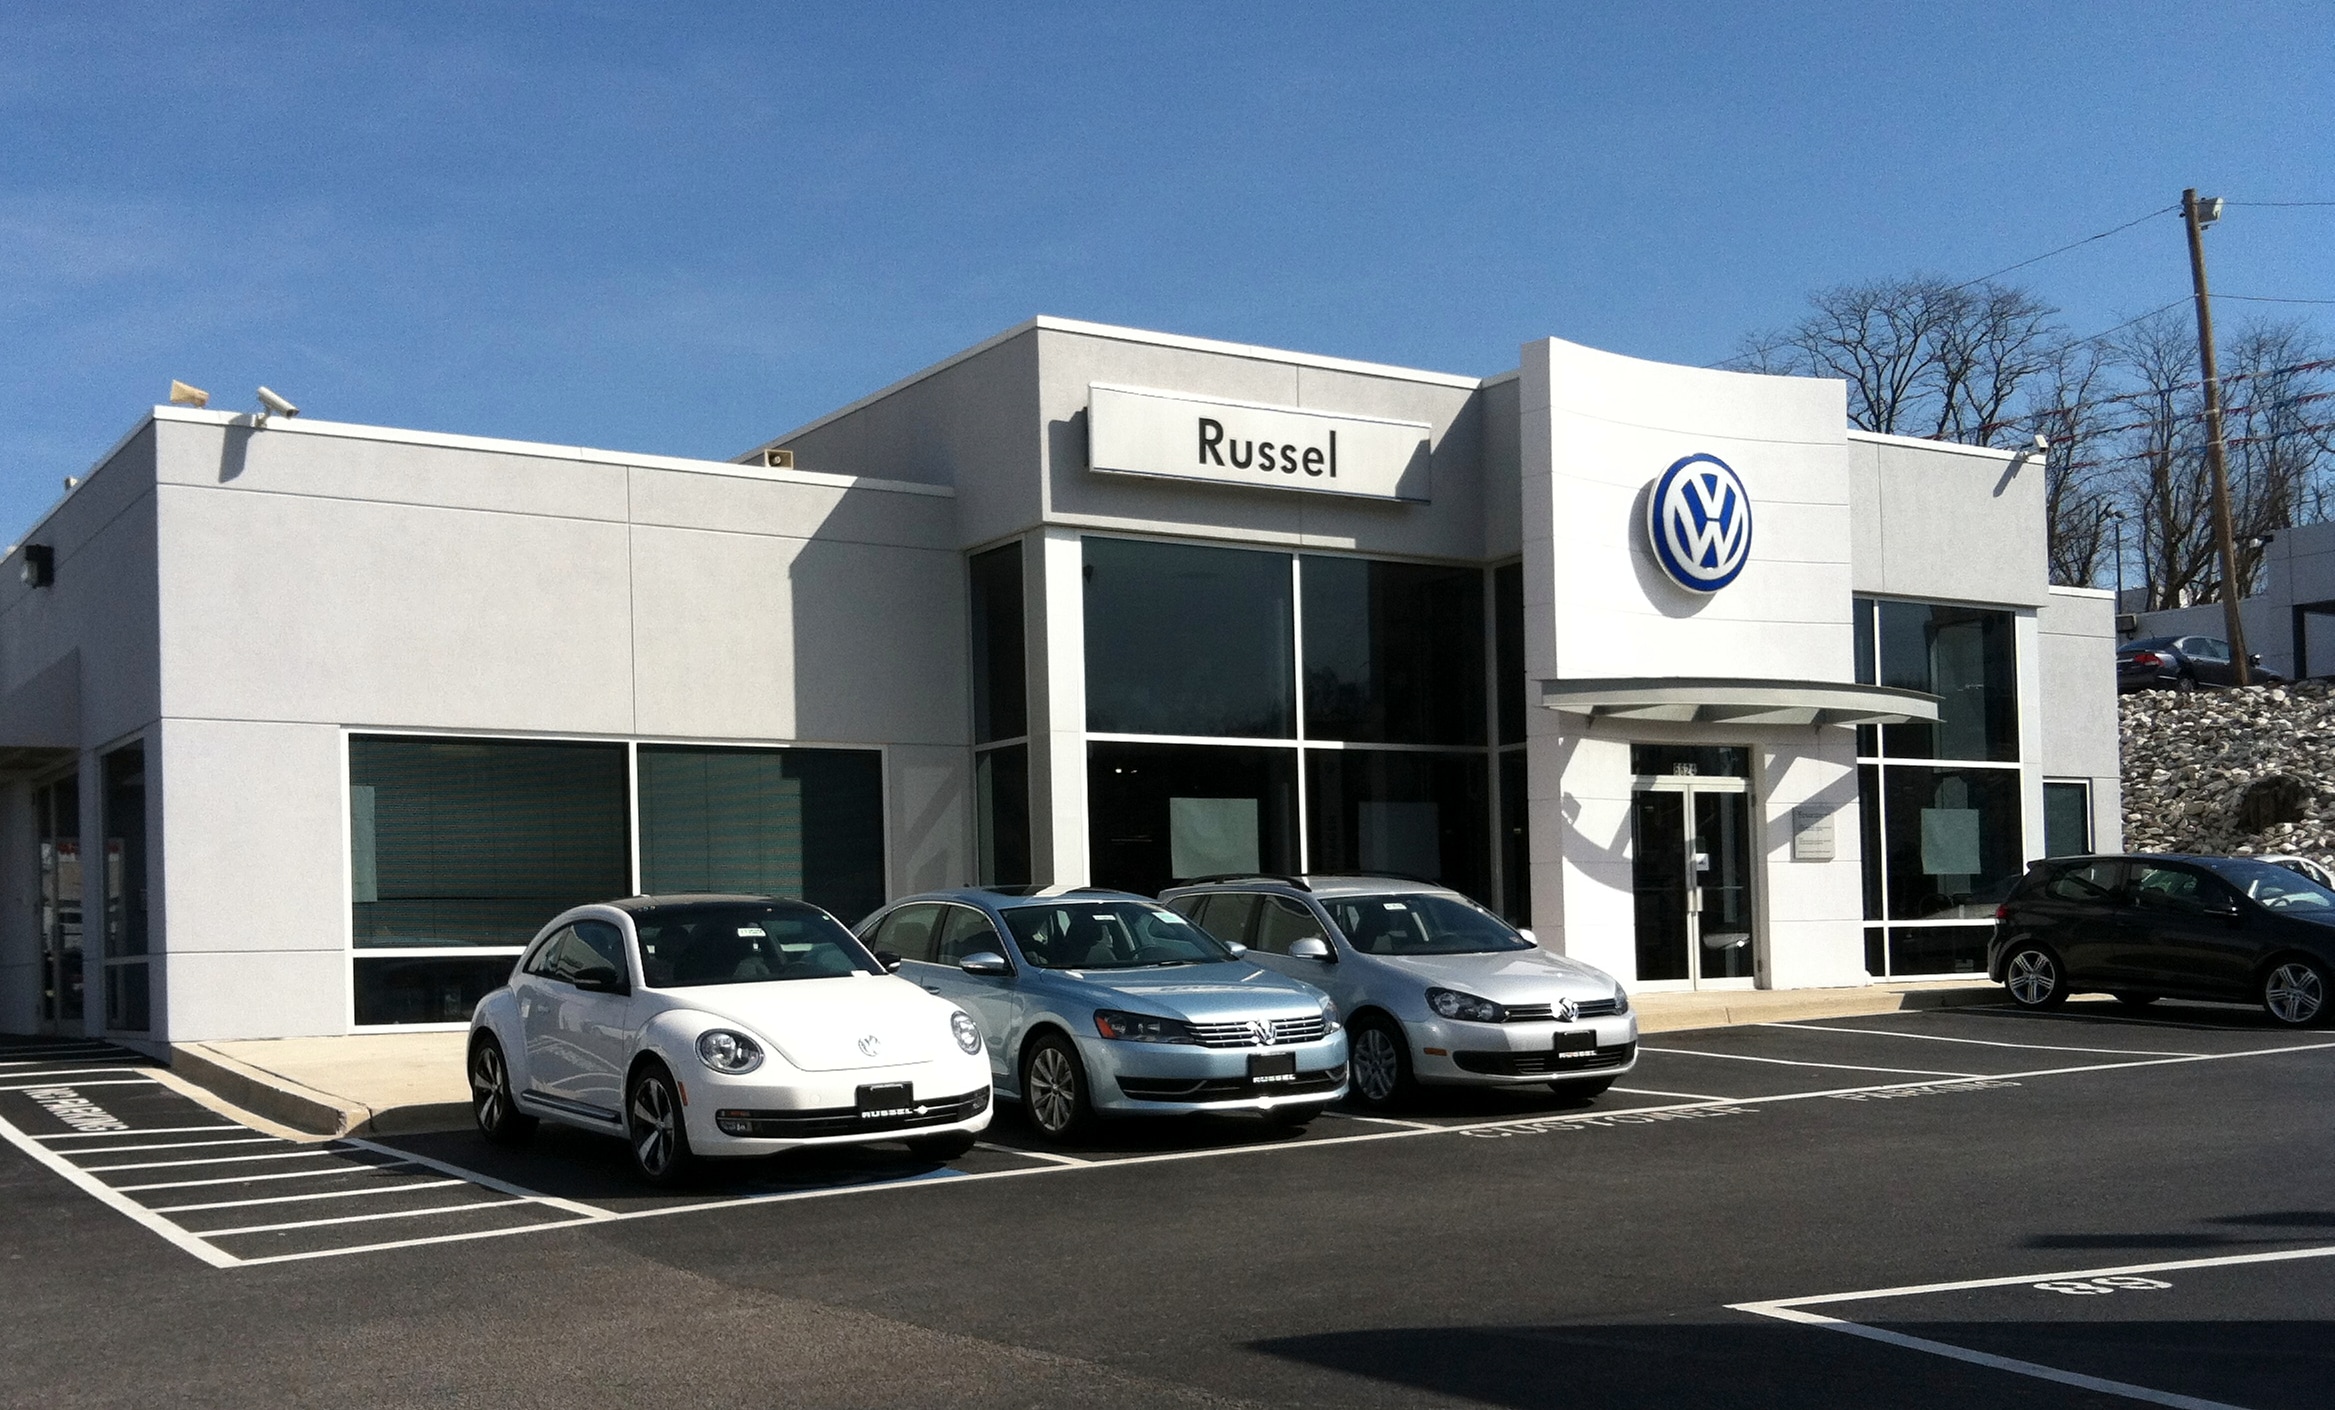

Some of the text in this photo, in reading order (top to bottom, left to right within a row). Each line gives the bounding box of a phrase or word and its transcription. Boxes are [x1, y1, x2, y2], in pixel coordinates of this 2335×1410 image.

[1199, 417, 1337, 478] Russel
[1660, 459, 1749, 582] VW
[1252, 1074, 1296, 1083] RUSSEL
[37, 1098, 130, 1131] PARKING
[861, 1108, 913, 1118] RUSSEL
[1459, 1105, 1761, 1138] CUSTOMER
